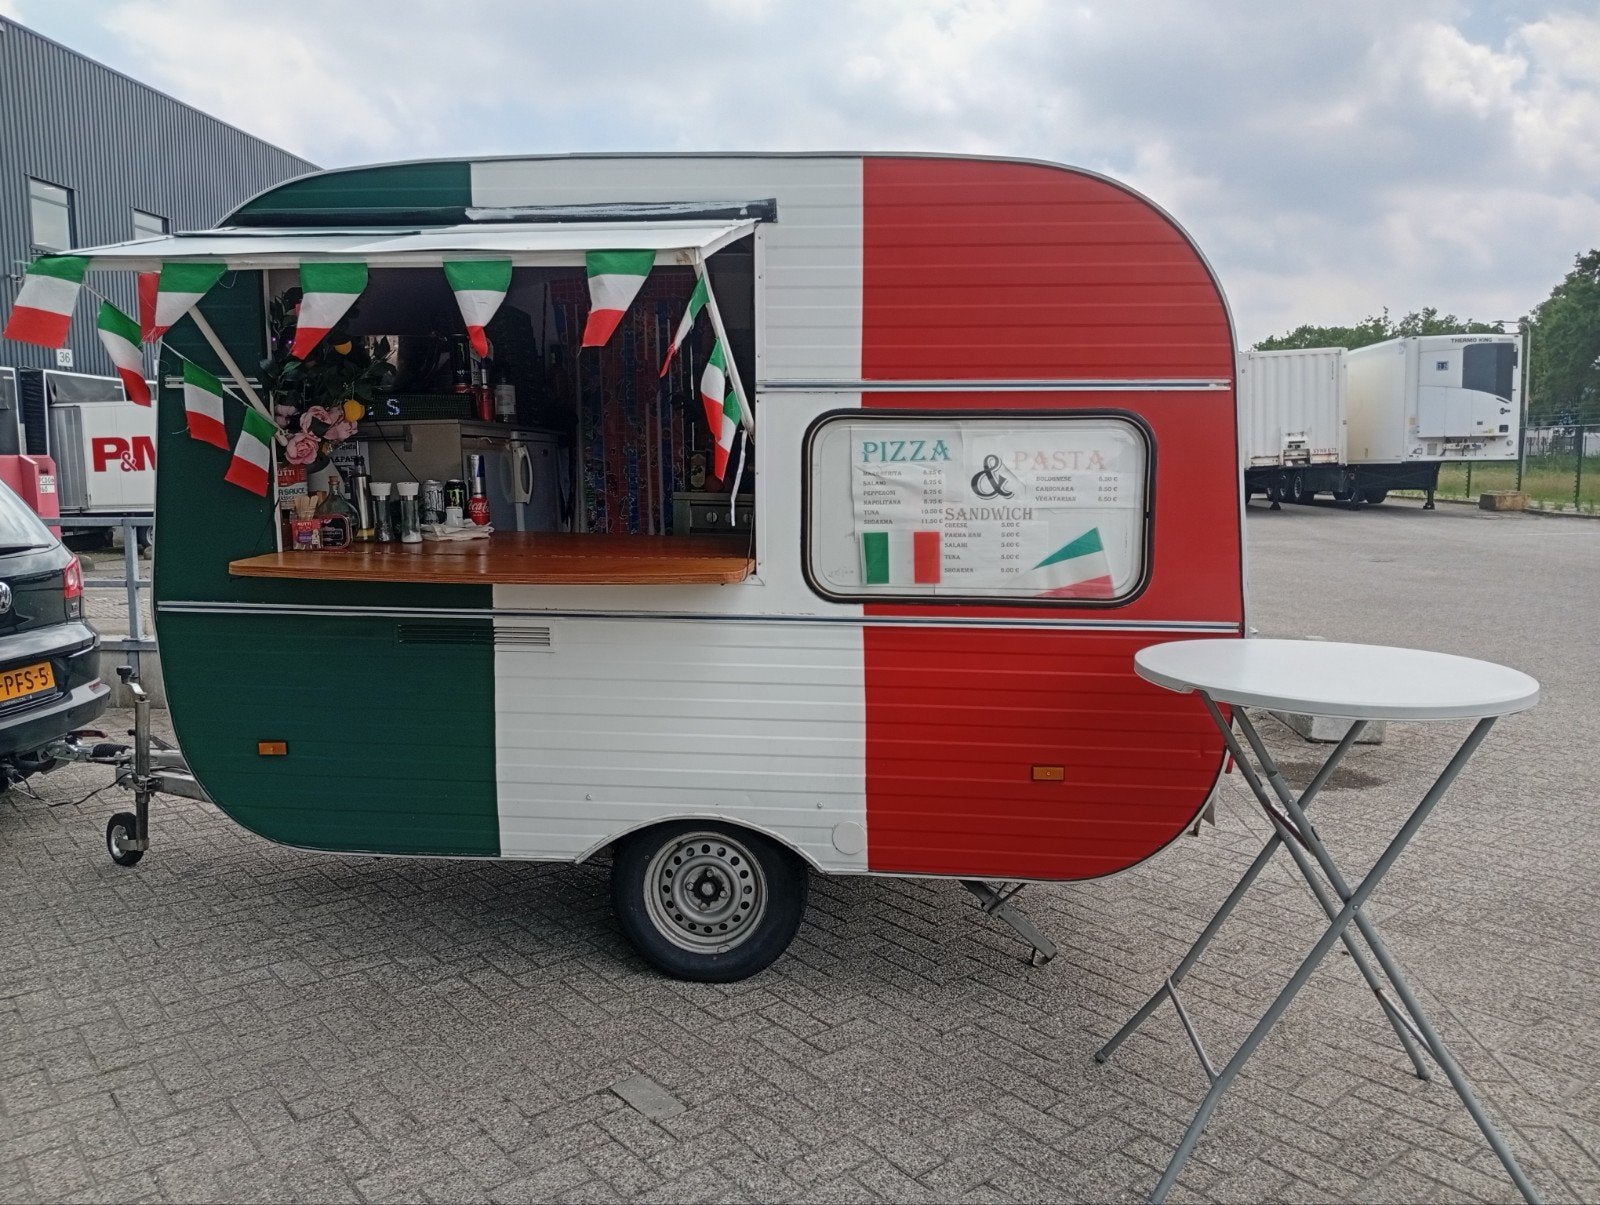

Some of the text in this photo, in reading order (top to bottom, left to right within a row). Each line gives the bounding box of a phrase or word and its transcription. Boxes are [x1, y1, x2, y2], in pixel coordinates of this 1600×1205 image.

[59, 351, 71, 363] 36
[862, 439, 952, 463] PIZZA
[1012, 450, 1106, 471] PASTA
[970, 454, 1015, 501] &
[944, 507, 1033, 521] SANDWICH
